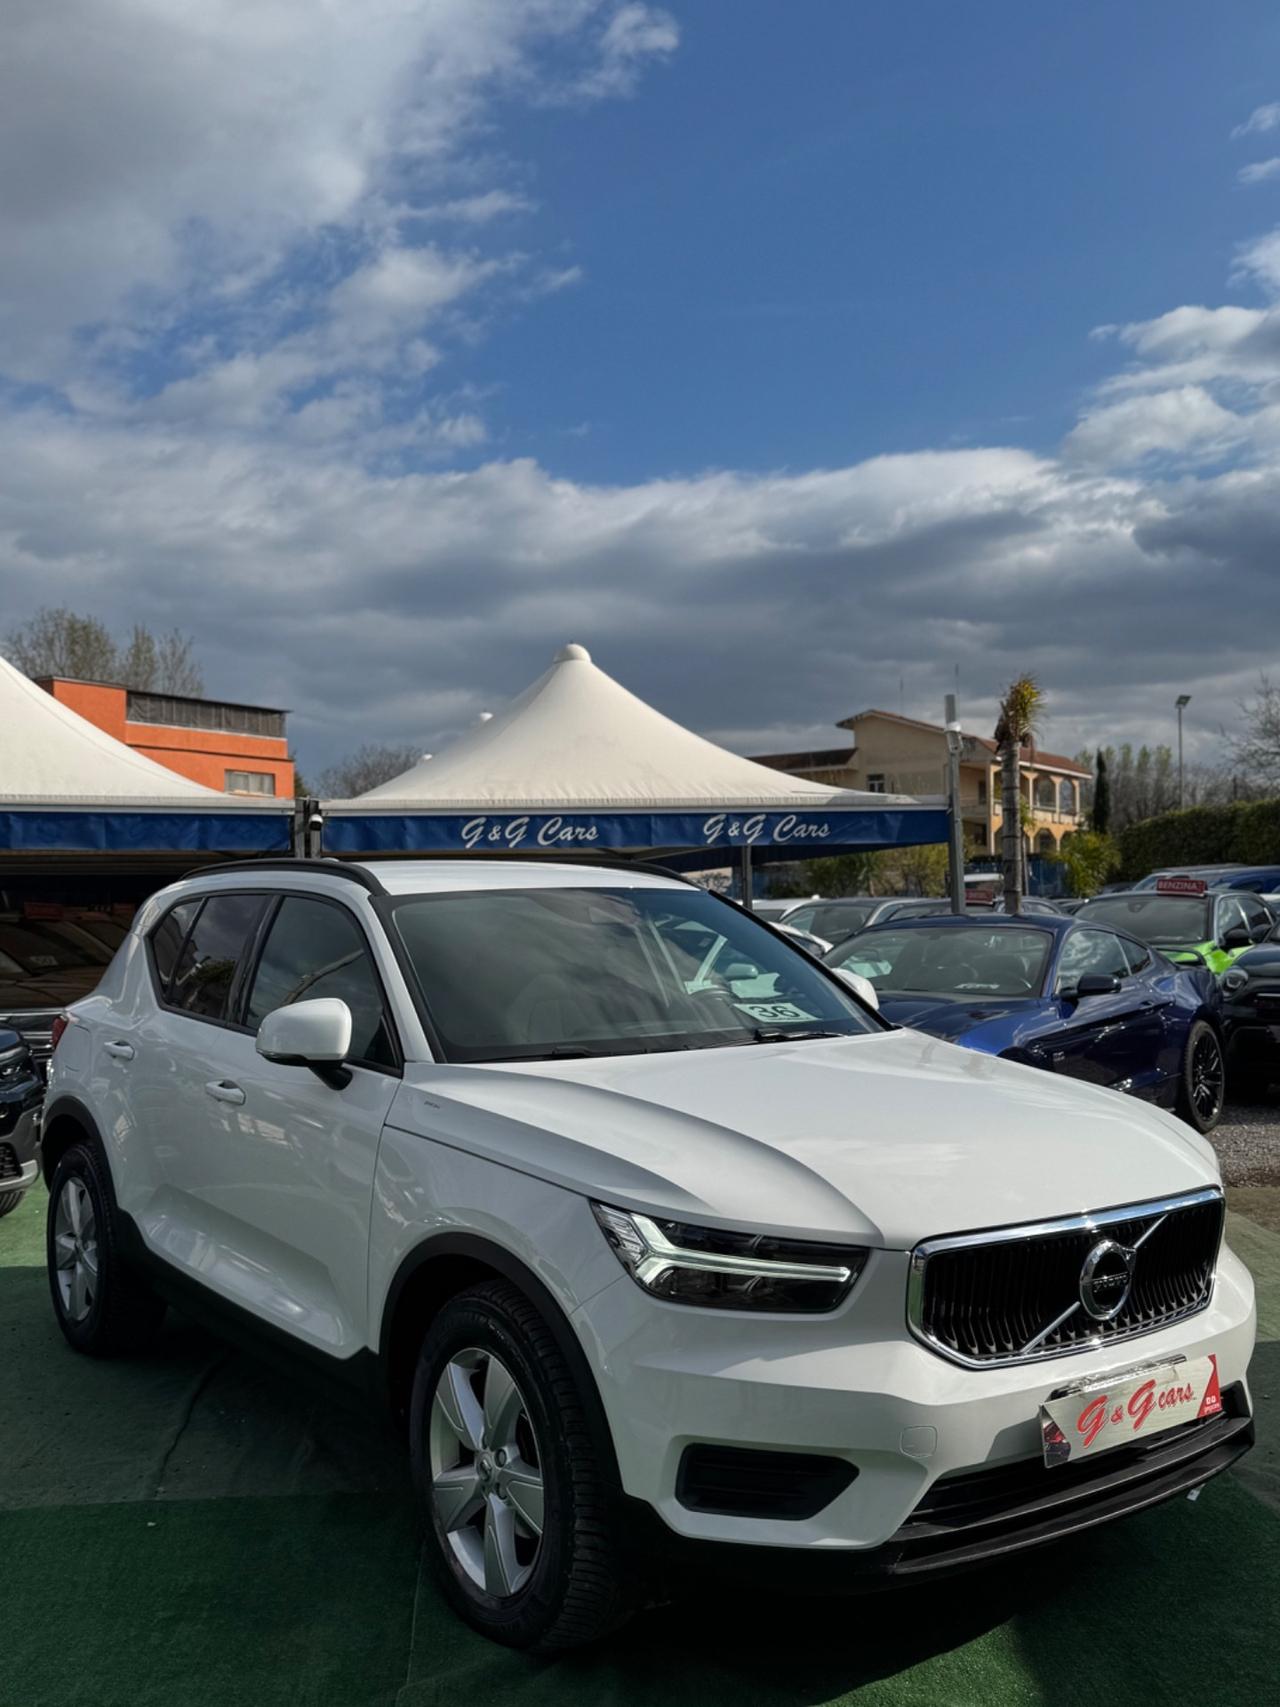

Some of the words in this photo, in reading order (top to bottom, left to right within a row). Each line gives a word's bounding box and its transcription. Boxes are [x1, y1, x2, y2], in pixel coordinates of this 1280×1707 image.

[537, 816, 599, 846] Cars
[773, 815, 830, 842] Cars
[748, 1005, 801, 1018] 36
[1158, 1383, 1194, 1411] cars
